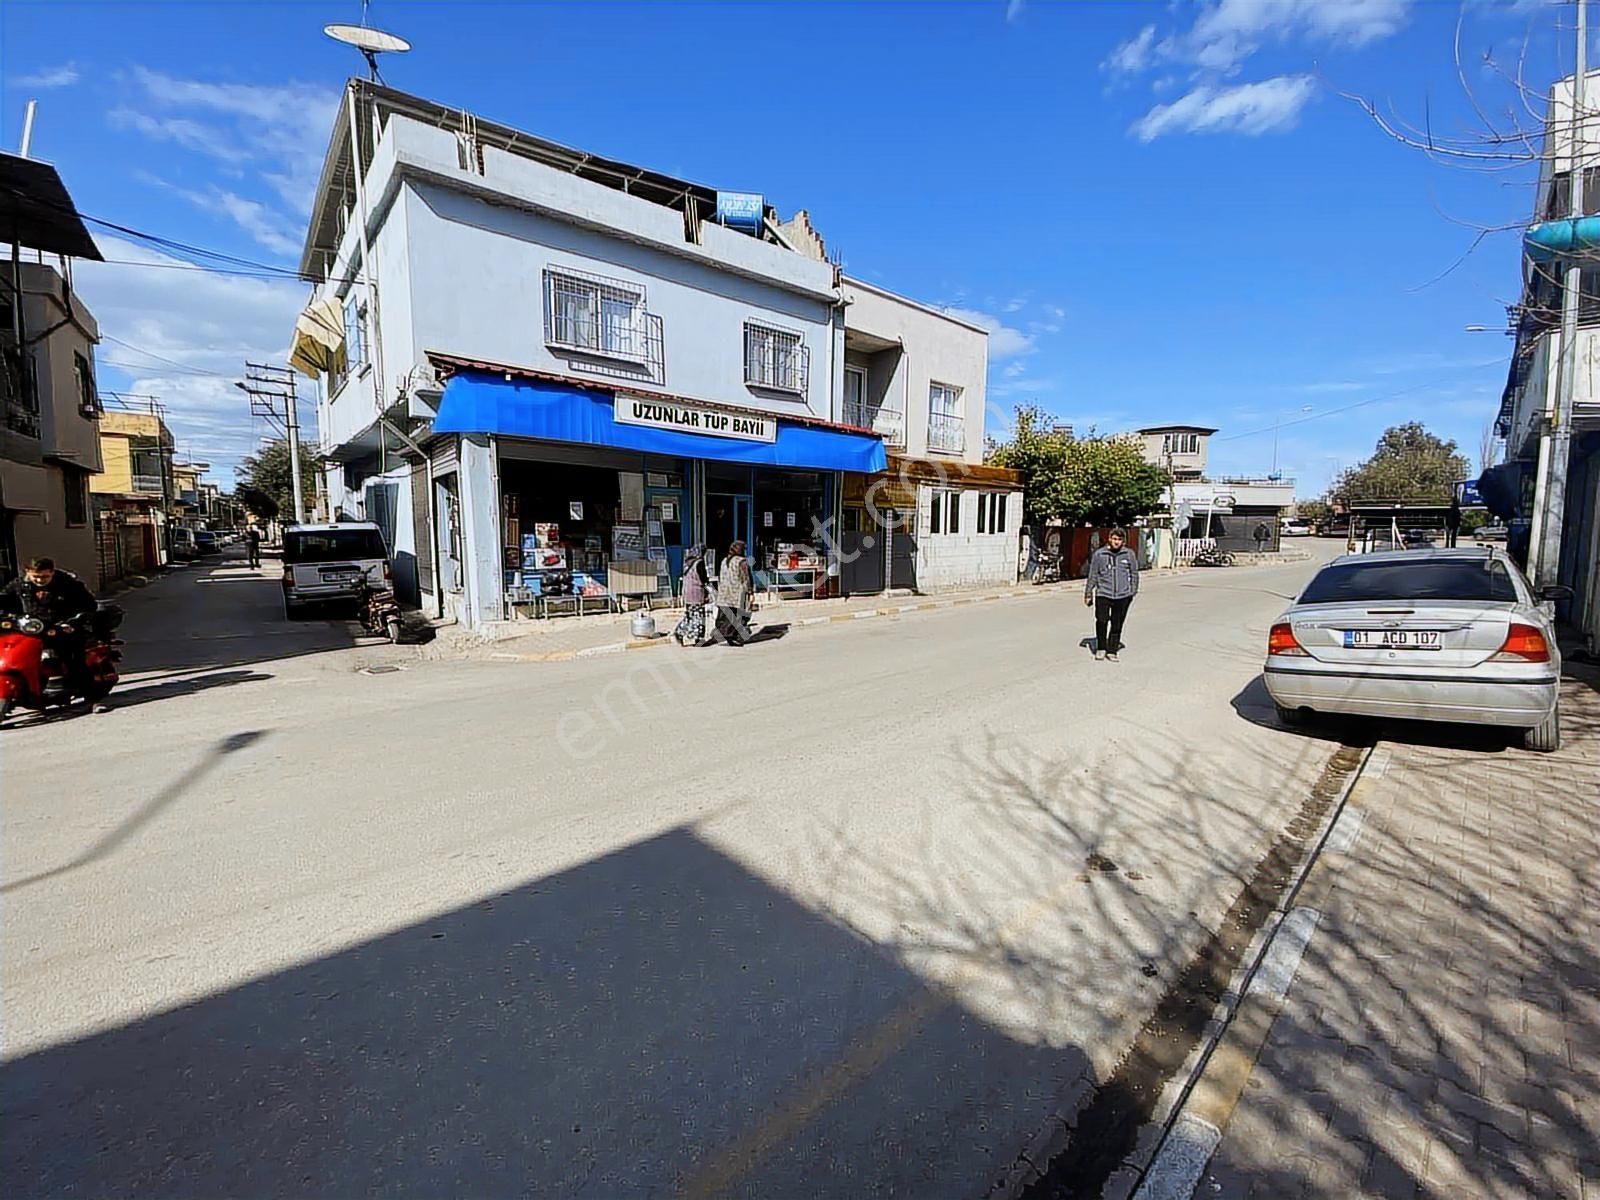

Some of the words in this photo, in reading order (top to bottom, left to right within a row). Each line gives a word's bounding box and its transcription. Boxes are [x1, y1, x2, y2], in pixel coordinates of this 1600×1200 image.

[633, 402, 699, 427] UZUNLAR
[703, 411, 728, 430] TÜP
[1354, 631, 1369, 643] 01
[1413, 632, 1438, 644] 107
